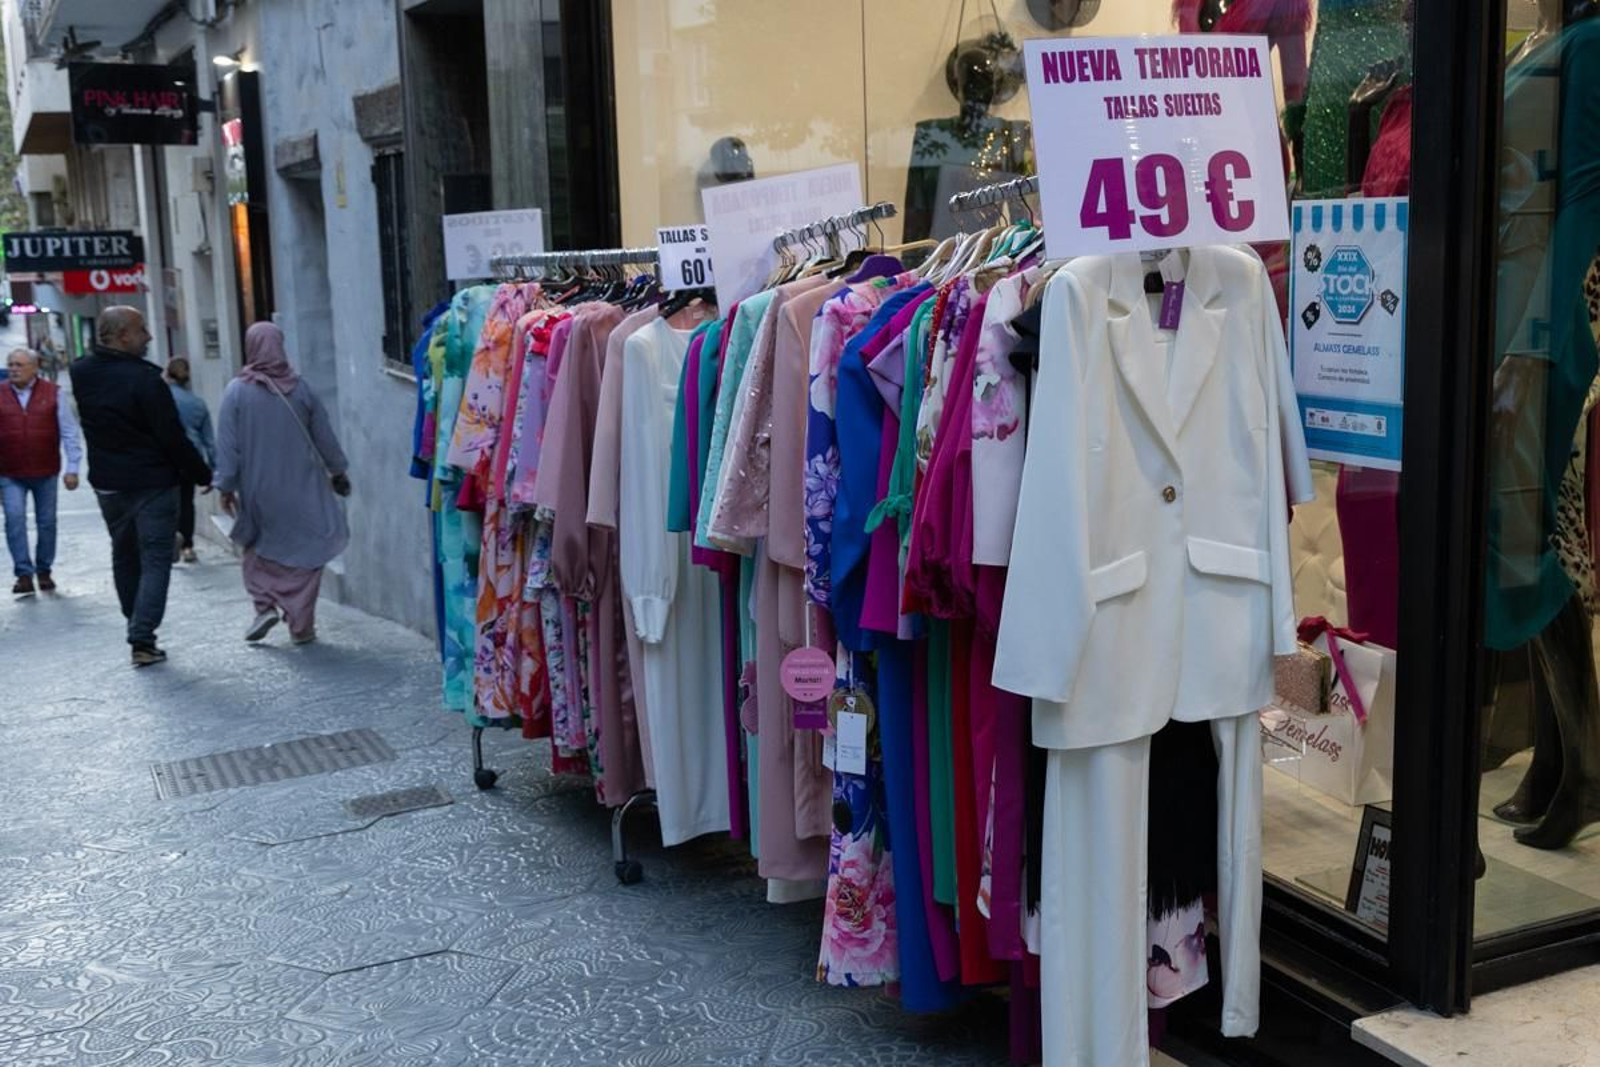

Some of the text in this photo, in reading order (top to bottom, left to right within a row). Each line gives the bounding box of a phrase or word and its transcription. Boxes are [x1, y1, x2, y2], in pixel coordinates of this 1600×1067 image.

[1040, 46, 1262, 85] NUEVA TEMPORADA
[133, 88, 180, 107] HAIR
[1103, 92, 1222, 120] TALLAS SUELTAS
[1080, 149, 1255, 240] 49 €
[8, 236, 131, 258] JUPITER
[660, 229, 697, 245] TALLAS
[1316, 273, 1378, 296] STOCK
